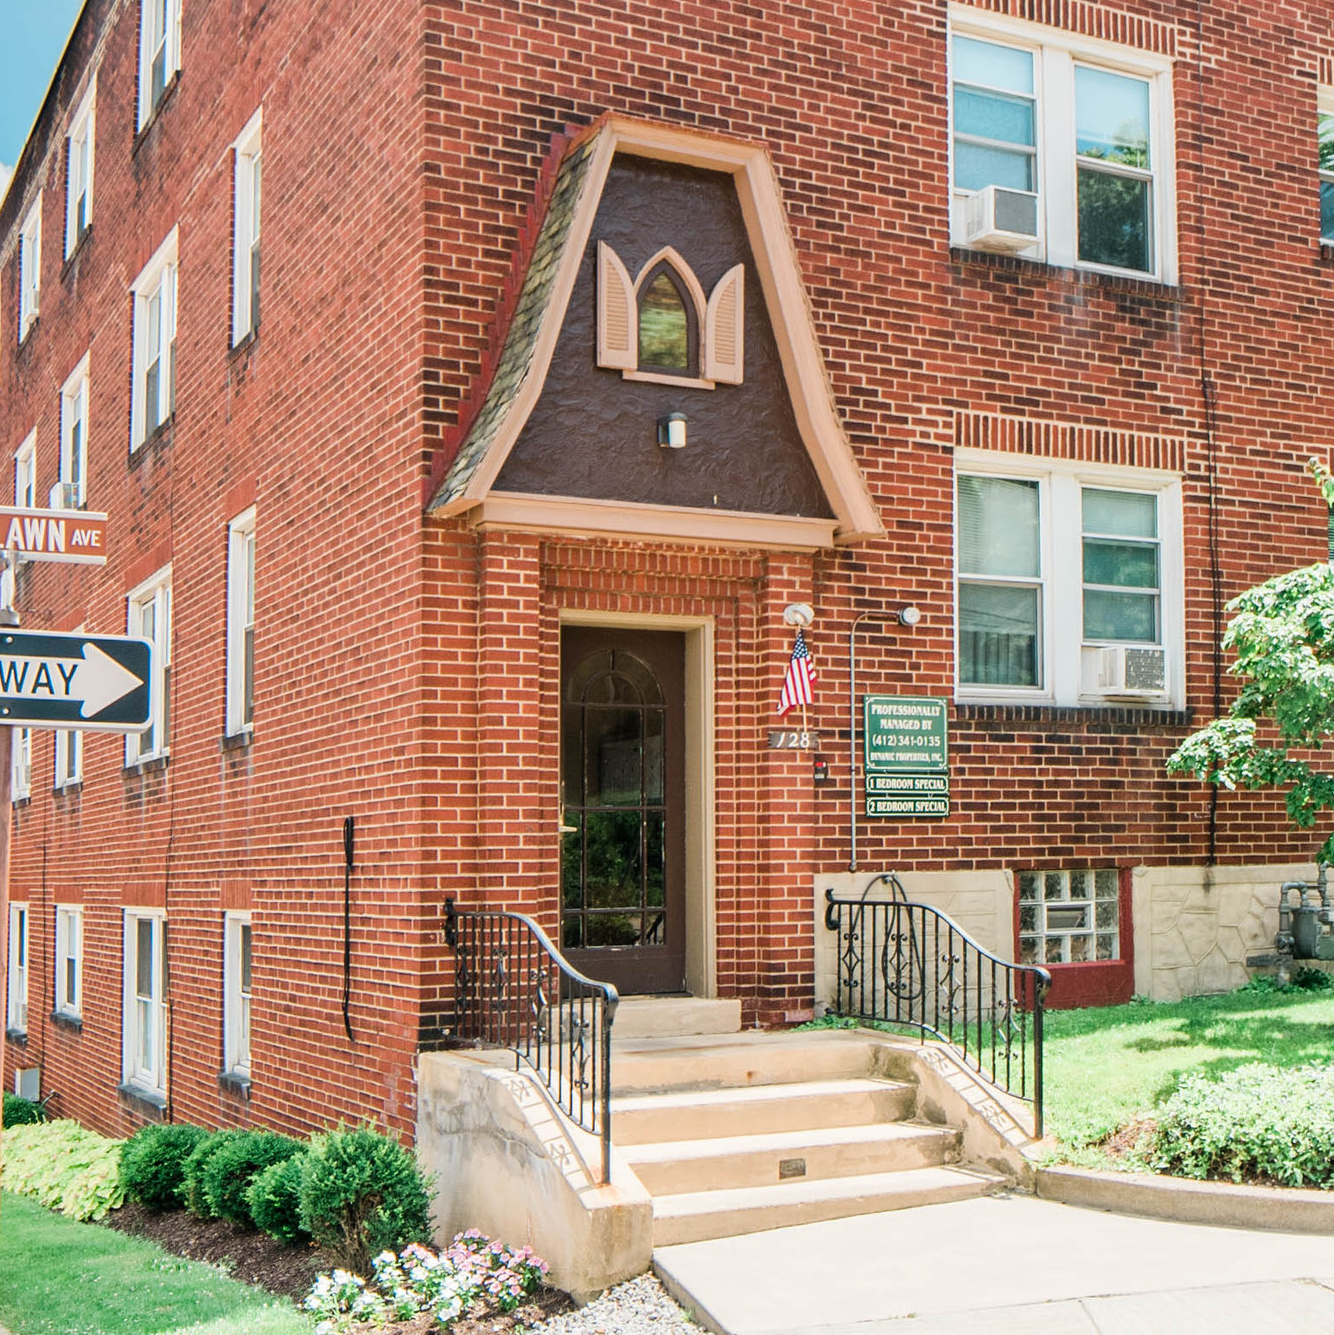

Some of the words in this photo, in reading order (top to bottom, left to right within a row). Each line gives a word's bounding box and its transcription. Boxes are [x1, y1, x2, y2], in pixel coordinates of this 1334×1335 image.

[70, 528, 102, 548] AVE
[871, 704, 941, 717] PROFESSIONALLY
[880, 718, 920, 730] MANAGED
[921, 719, 932, 730] BY
[776, 731, 810, 748] 128
[875, 778, 914, 790] BEDROOM
[914, 779, 945, 790] SPECIAL
[870, 801, 876, 812] 2
[876, 801, 914, 812] BEDROOM
[915, 801, 946, 812] SPECIAL
